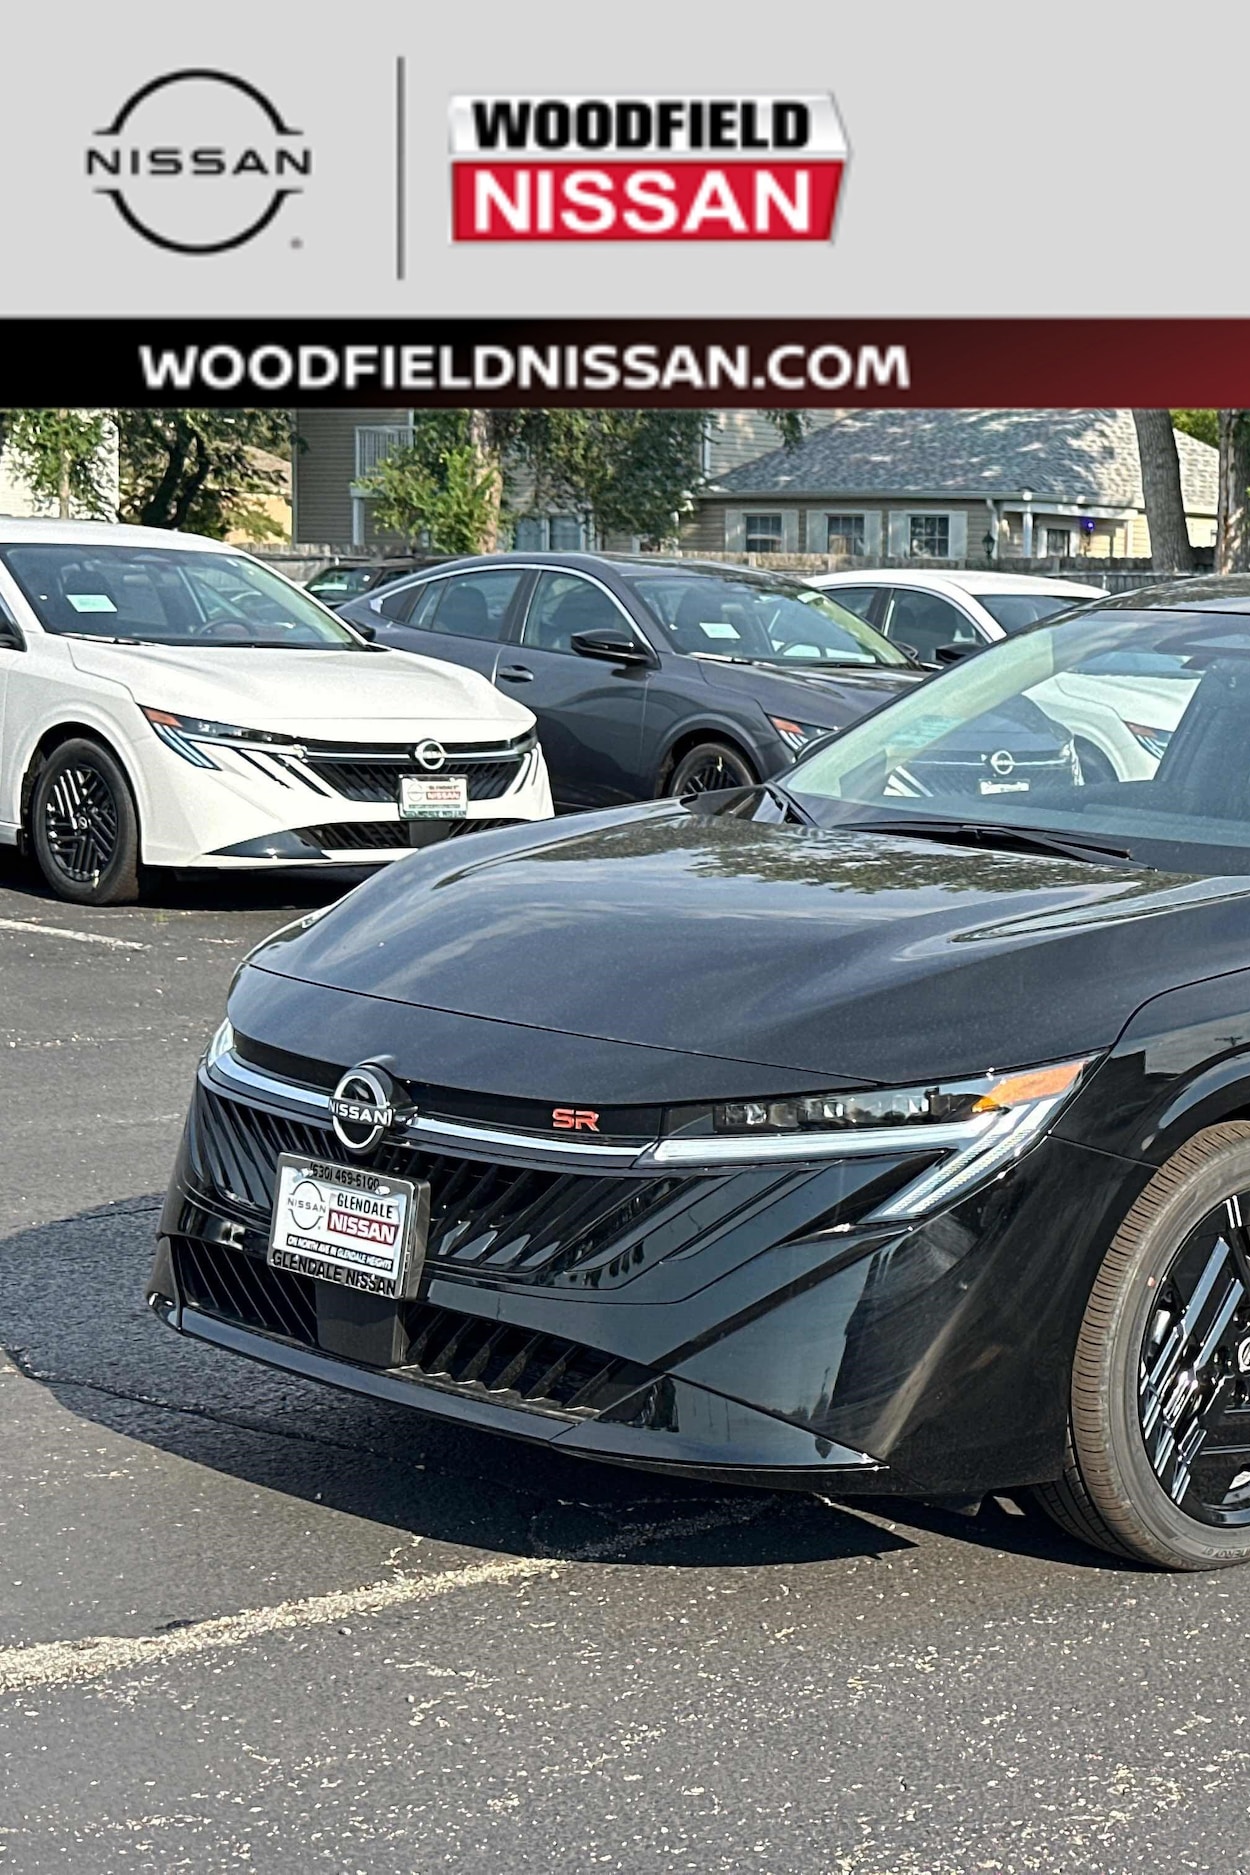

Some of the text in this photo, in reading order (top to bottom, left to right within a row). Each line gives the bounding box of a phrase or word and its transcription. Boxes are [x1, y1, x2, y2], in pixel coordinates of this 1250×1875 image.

[328, 1099, 390, 1126] NISSAN
[552, 1108, 599, 1132] SR
[287, 1197, 326, 1214] NISSAN
[337, 1192, 394, 1219] GLENDALE
[329, 1212, 396, 1244] NISSAN
[272, 1249, 396, 1297] GLENDALE NISSAN
